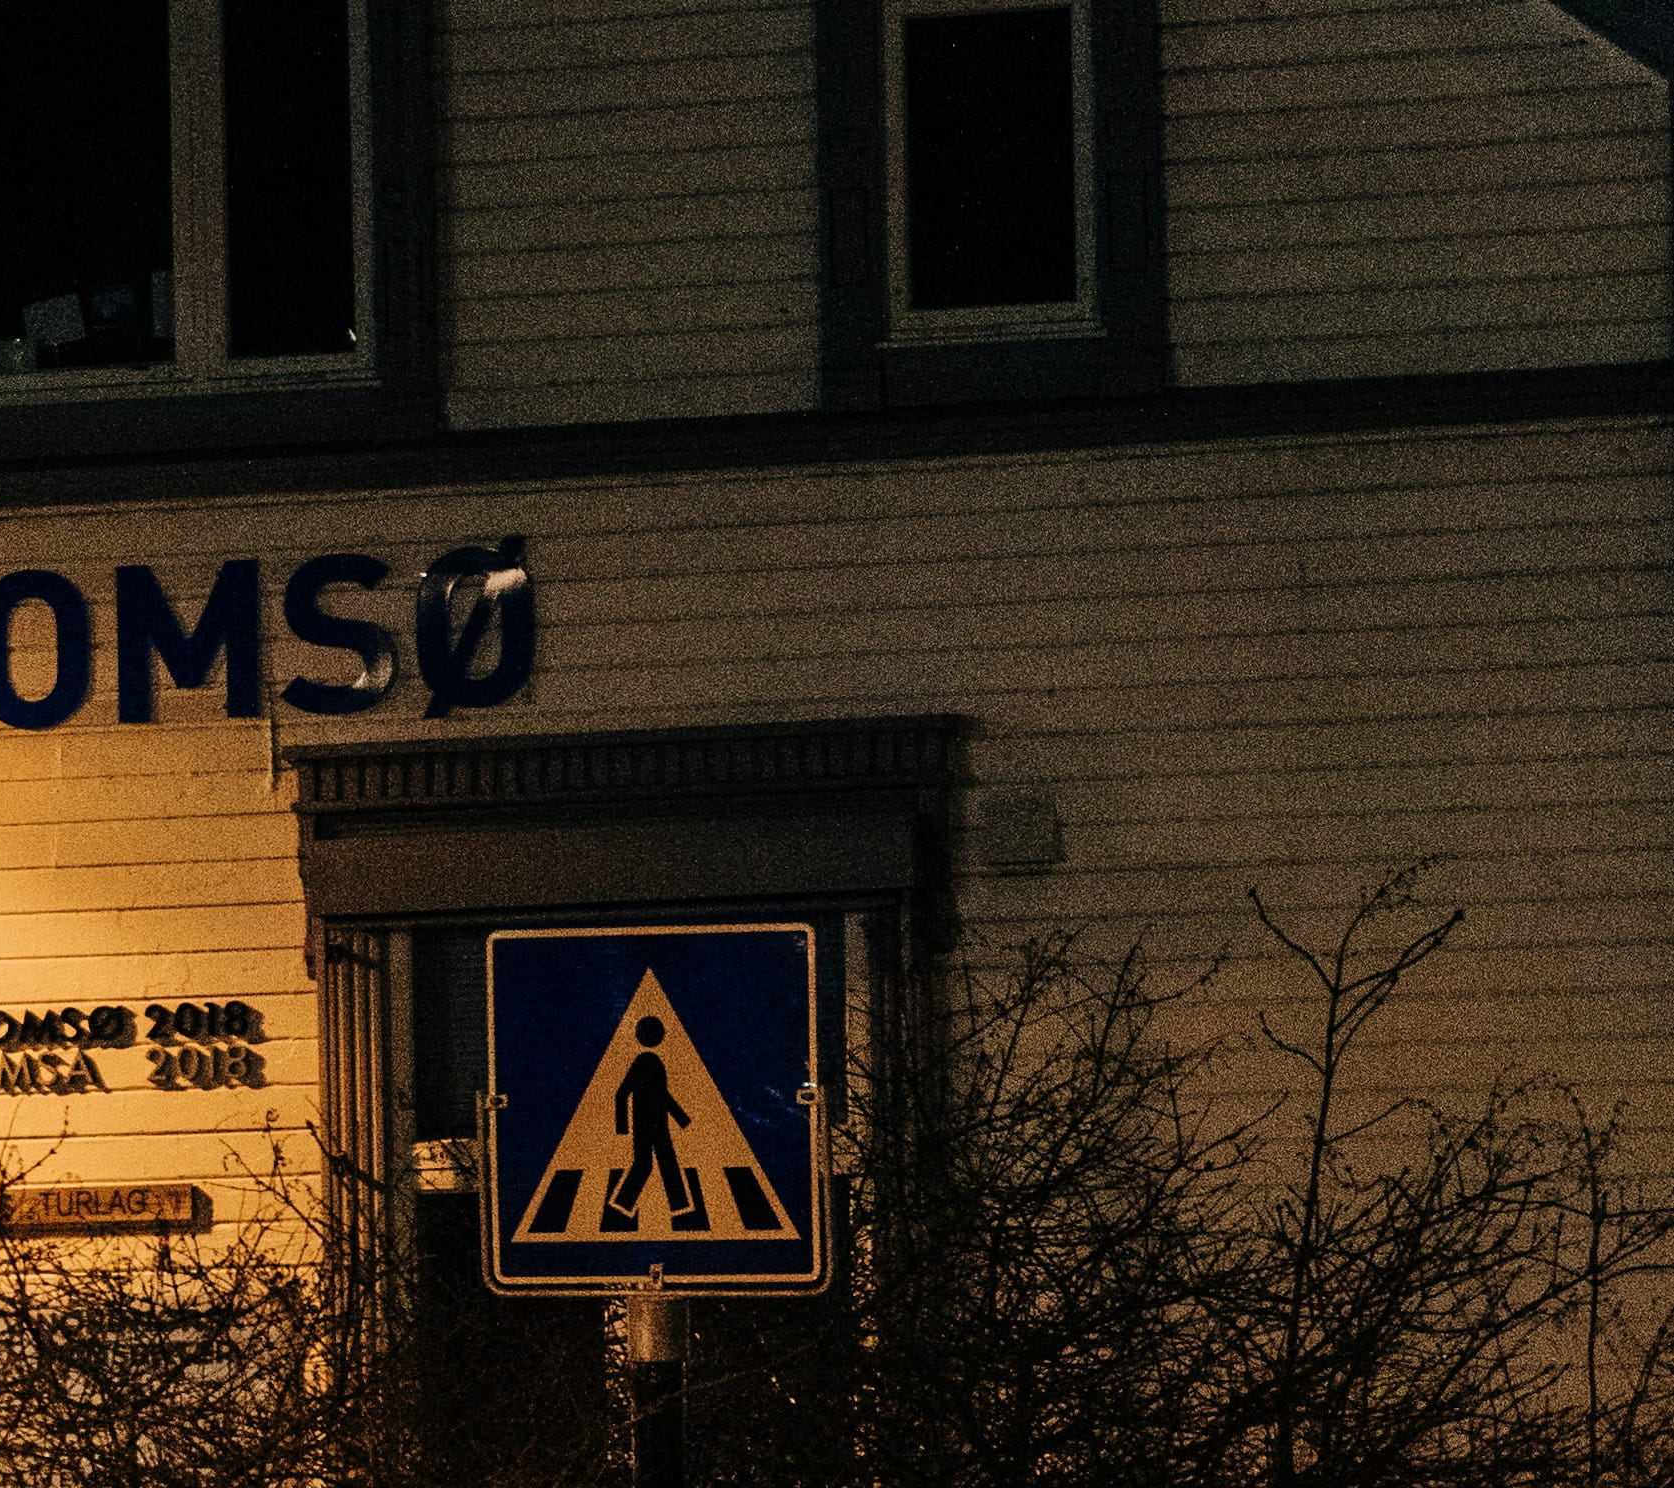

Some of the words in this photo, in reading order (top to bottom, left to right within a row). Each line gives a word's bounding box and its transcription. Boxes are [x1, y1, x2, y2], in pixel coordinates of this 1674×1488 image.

[144, 1000, 252, 1041] 2018
[146, 1045, 249, 1082] 2018
[40, 1188, 148, 1217] TURLAG
